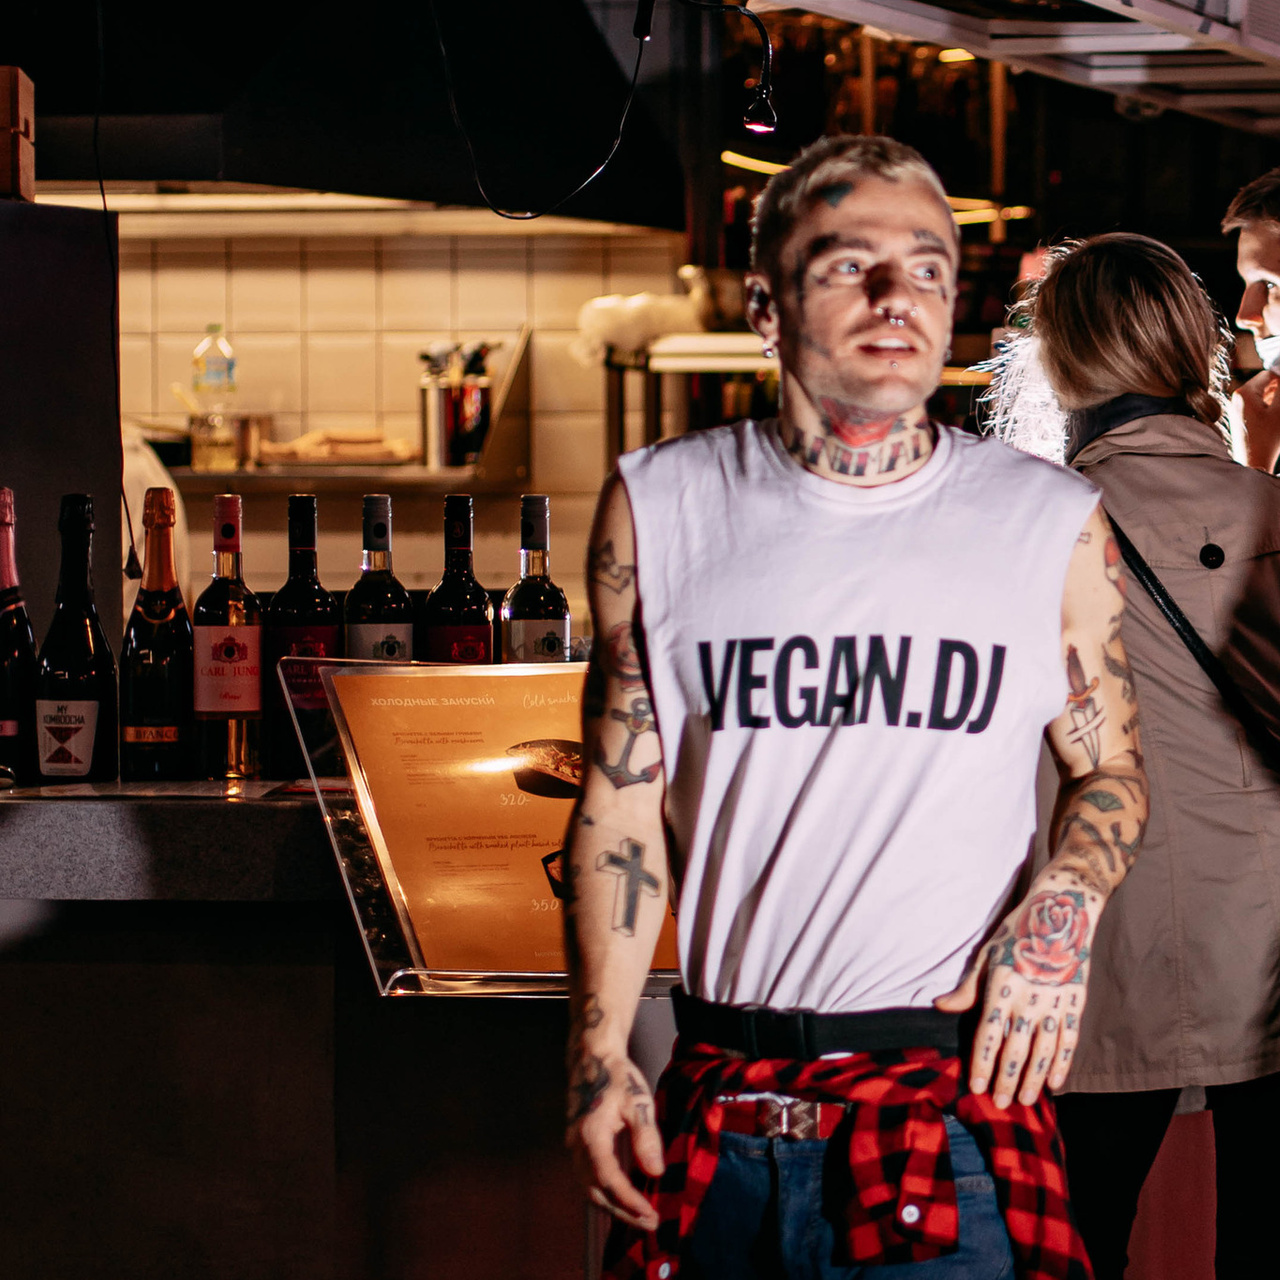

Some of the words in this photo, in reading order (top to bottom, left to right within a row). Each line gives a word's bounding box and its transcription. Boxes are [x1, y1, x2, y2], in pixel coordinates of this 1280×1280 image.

[200, 666, 226, 677] CARL
[697, 634, 1007, 735] VEGAN.DJ
[371, 697, 439, 707] ХОЛОДНЫЕ
[440, 695, 495, 707] ЗАКУСКИ
[522, 694, 546, 709] Cold
[547, 691, 579, 706] snacks
[57, 705, 68, 714] MY
